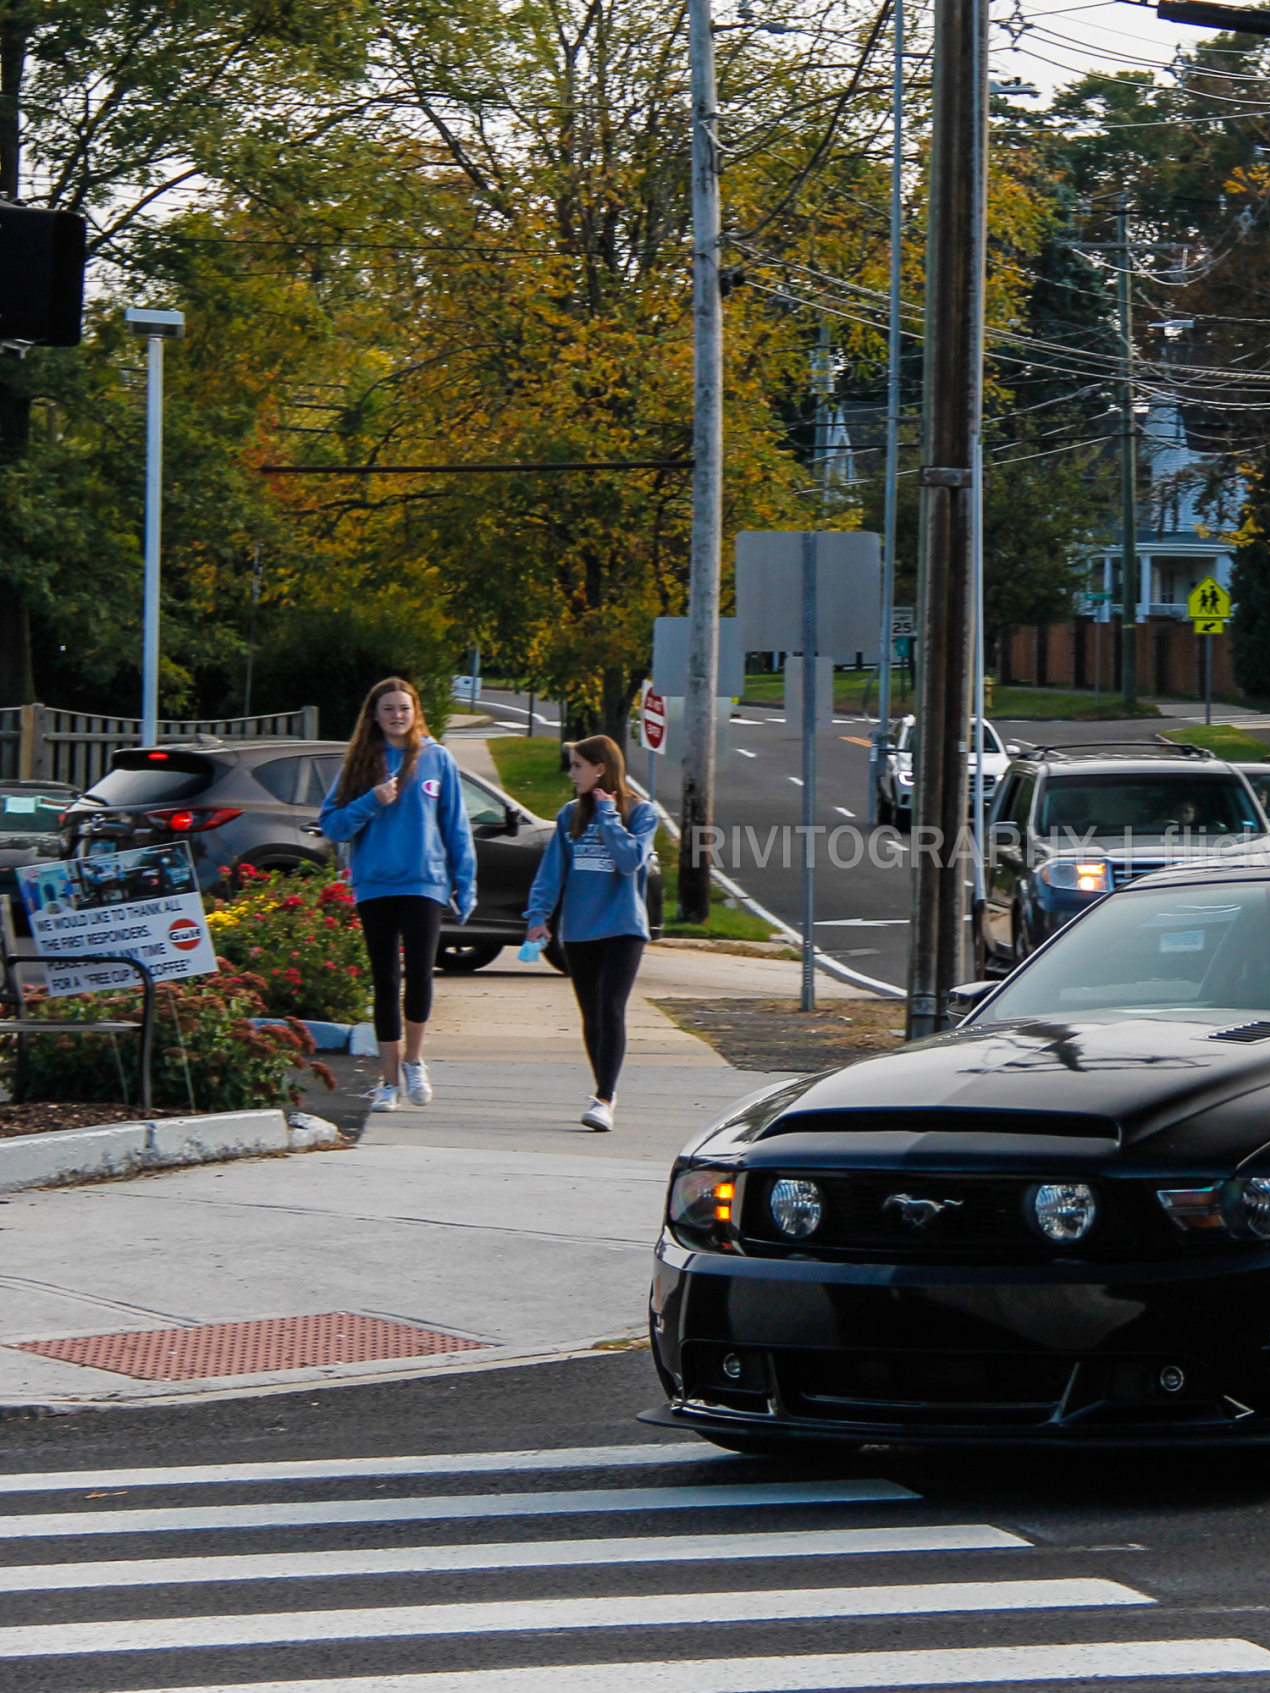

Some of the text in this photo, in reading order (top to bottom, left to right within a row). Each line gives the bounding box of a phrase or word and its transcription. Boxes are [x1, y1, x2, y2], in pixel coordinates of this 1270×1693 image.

[892, 622, 912, 634] 25
[35, 899, 183, 932] WE WOULD LIKE TO THANK ALL
[40, 938, 61, 951] THE
[61, 934, 85, 949] FIRST
[169, 928, 202, 941] Gulf
[140, 942, 167, 957] TIME
[51, 977, 72, 991] FOR
[73, 976, 83, 988] A
[111, 968, 130, 983] CUP
